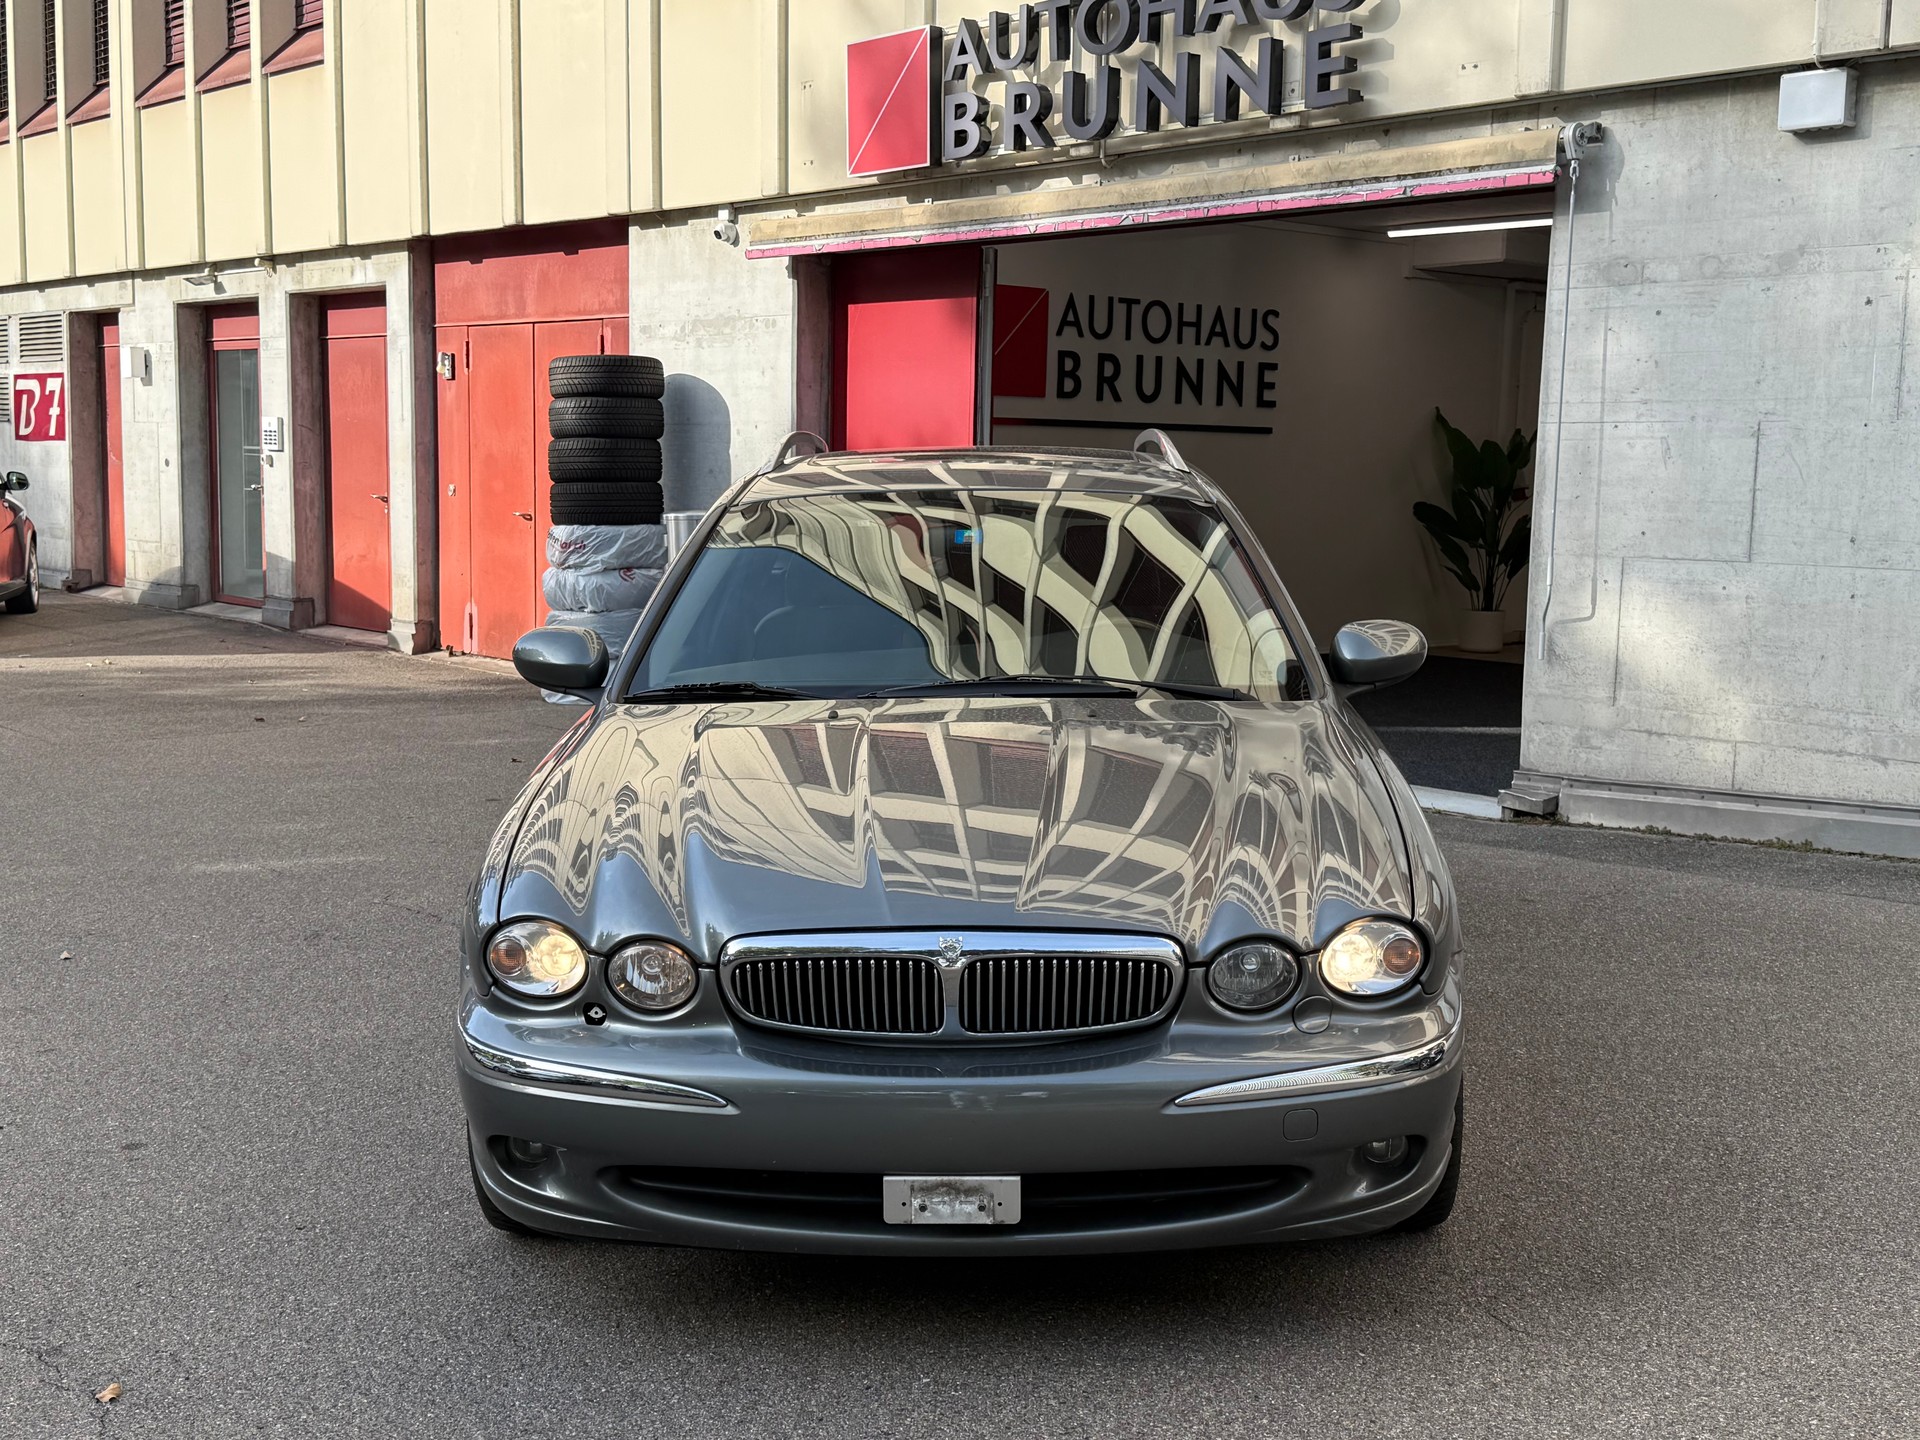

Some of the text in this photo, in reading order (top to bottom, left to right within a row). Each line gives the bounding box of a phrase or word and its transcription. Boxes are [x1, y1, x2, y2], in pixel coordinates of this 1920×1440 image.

[944, 22, 1362, 161] BRUNNE
[1055, 291, 1280, 351] AUTOHAUS
[1055, 349, 1280, 409] BRUNNE
